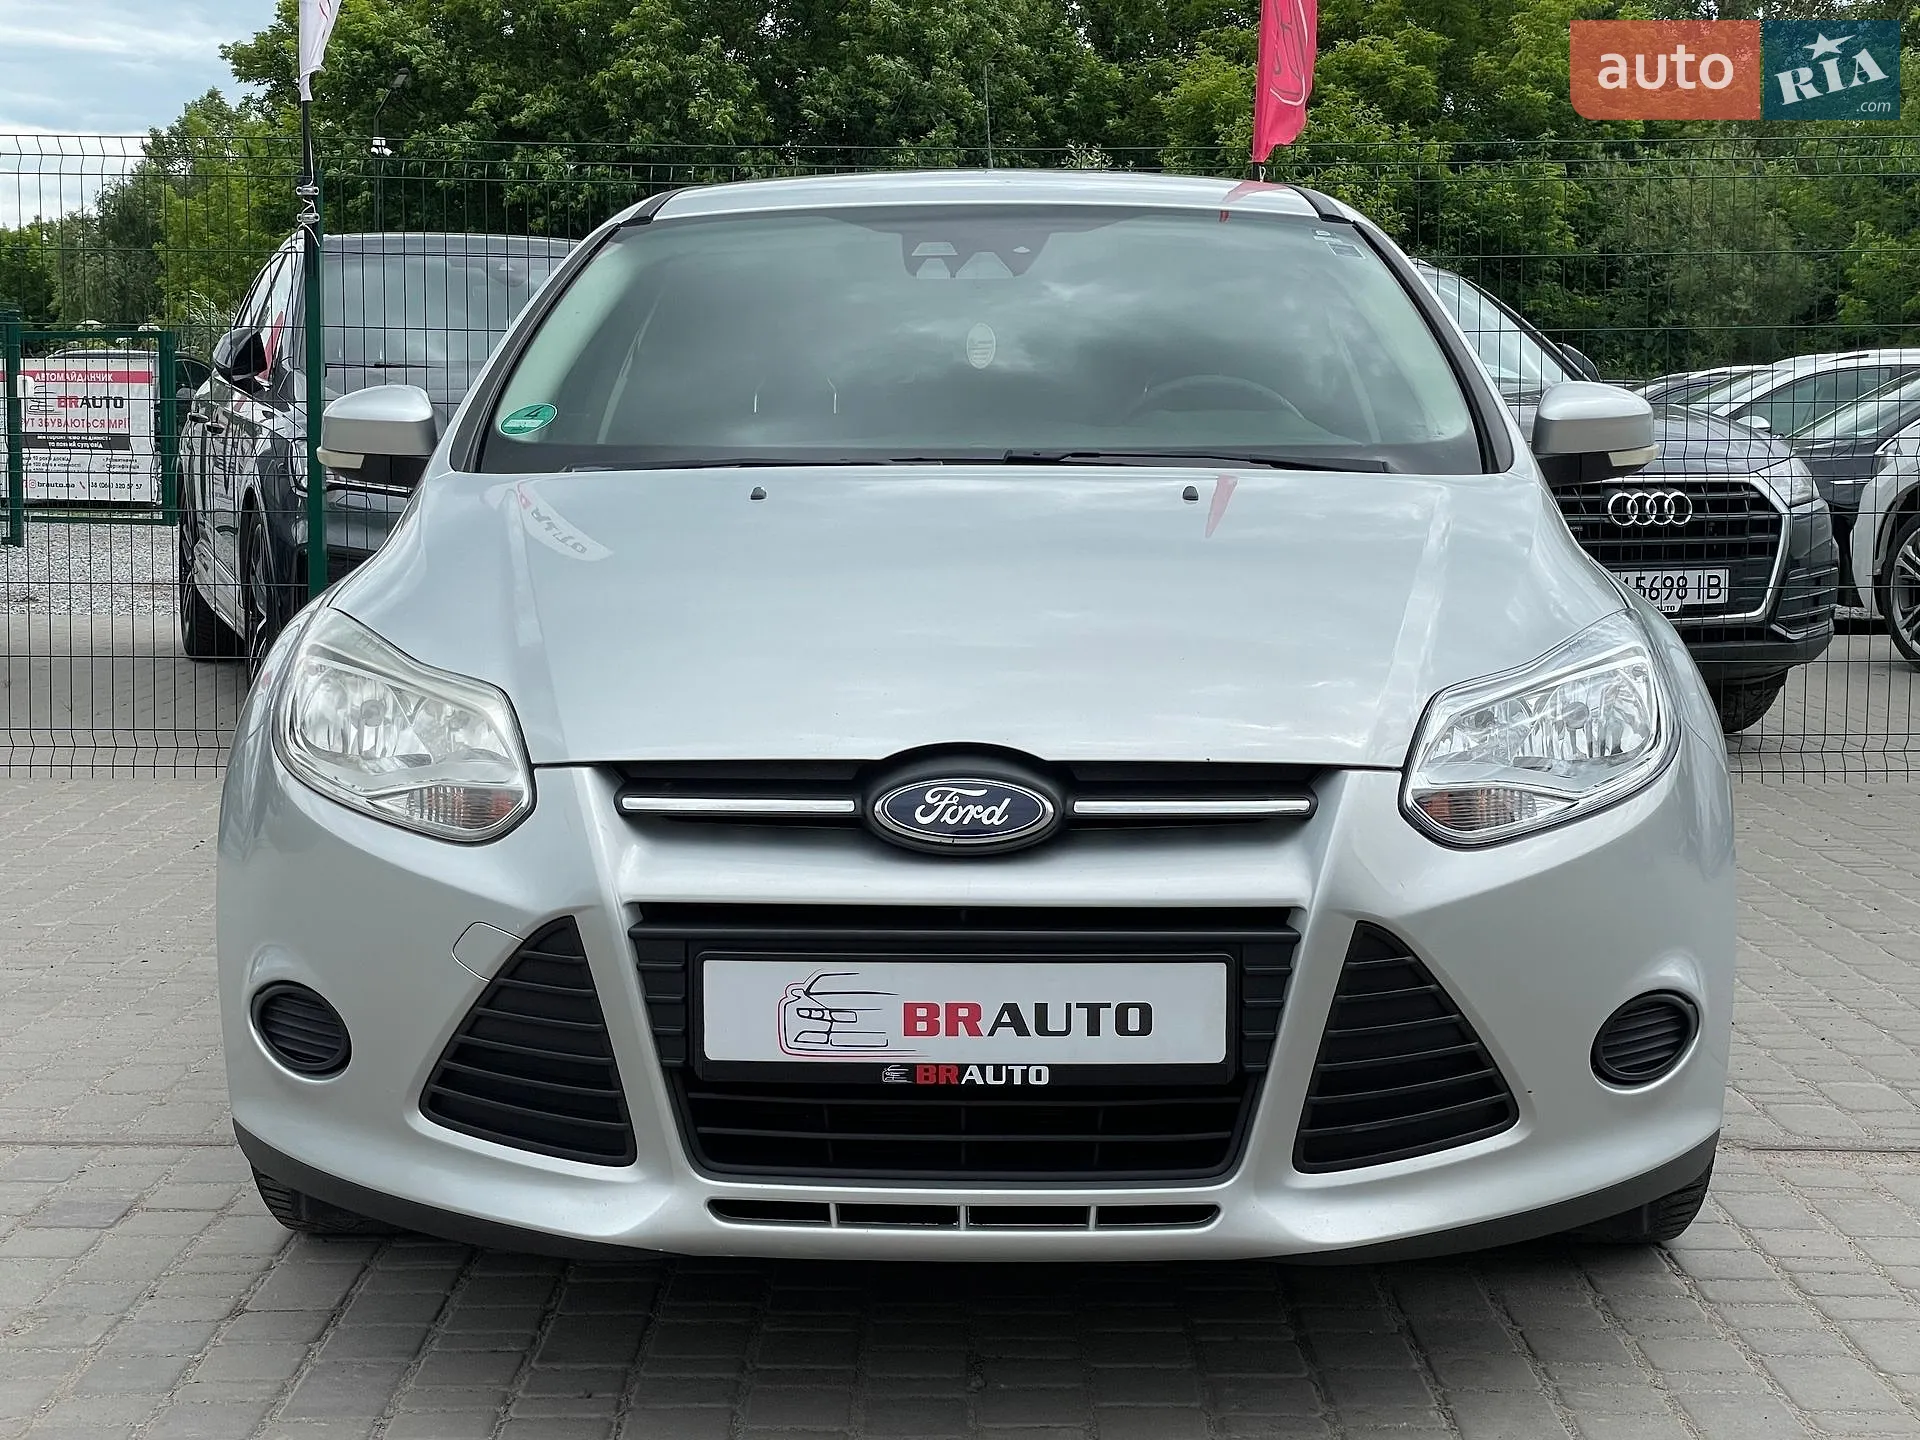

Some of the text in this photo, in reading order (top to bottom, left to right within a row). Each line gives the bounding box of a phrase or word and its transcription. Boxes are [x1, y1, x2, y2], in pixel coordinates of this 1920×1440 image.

[57, 396, 124, 409] BRAUTO
[1697, 574, 1722, 600] IB
[914, 786, 1012, 826] Ford
[903, 1002, 1153, 1037] BRAUTO
[916, 1065, 1050, 1085] BRAUTO
